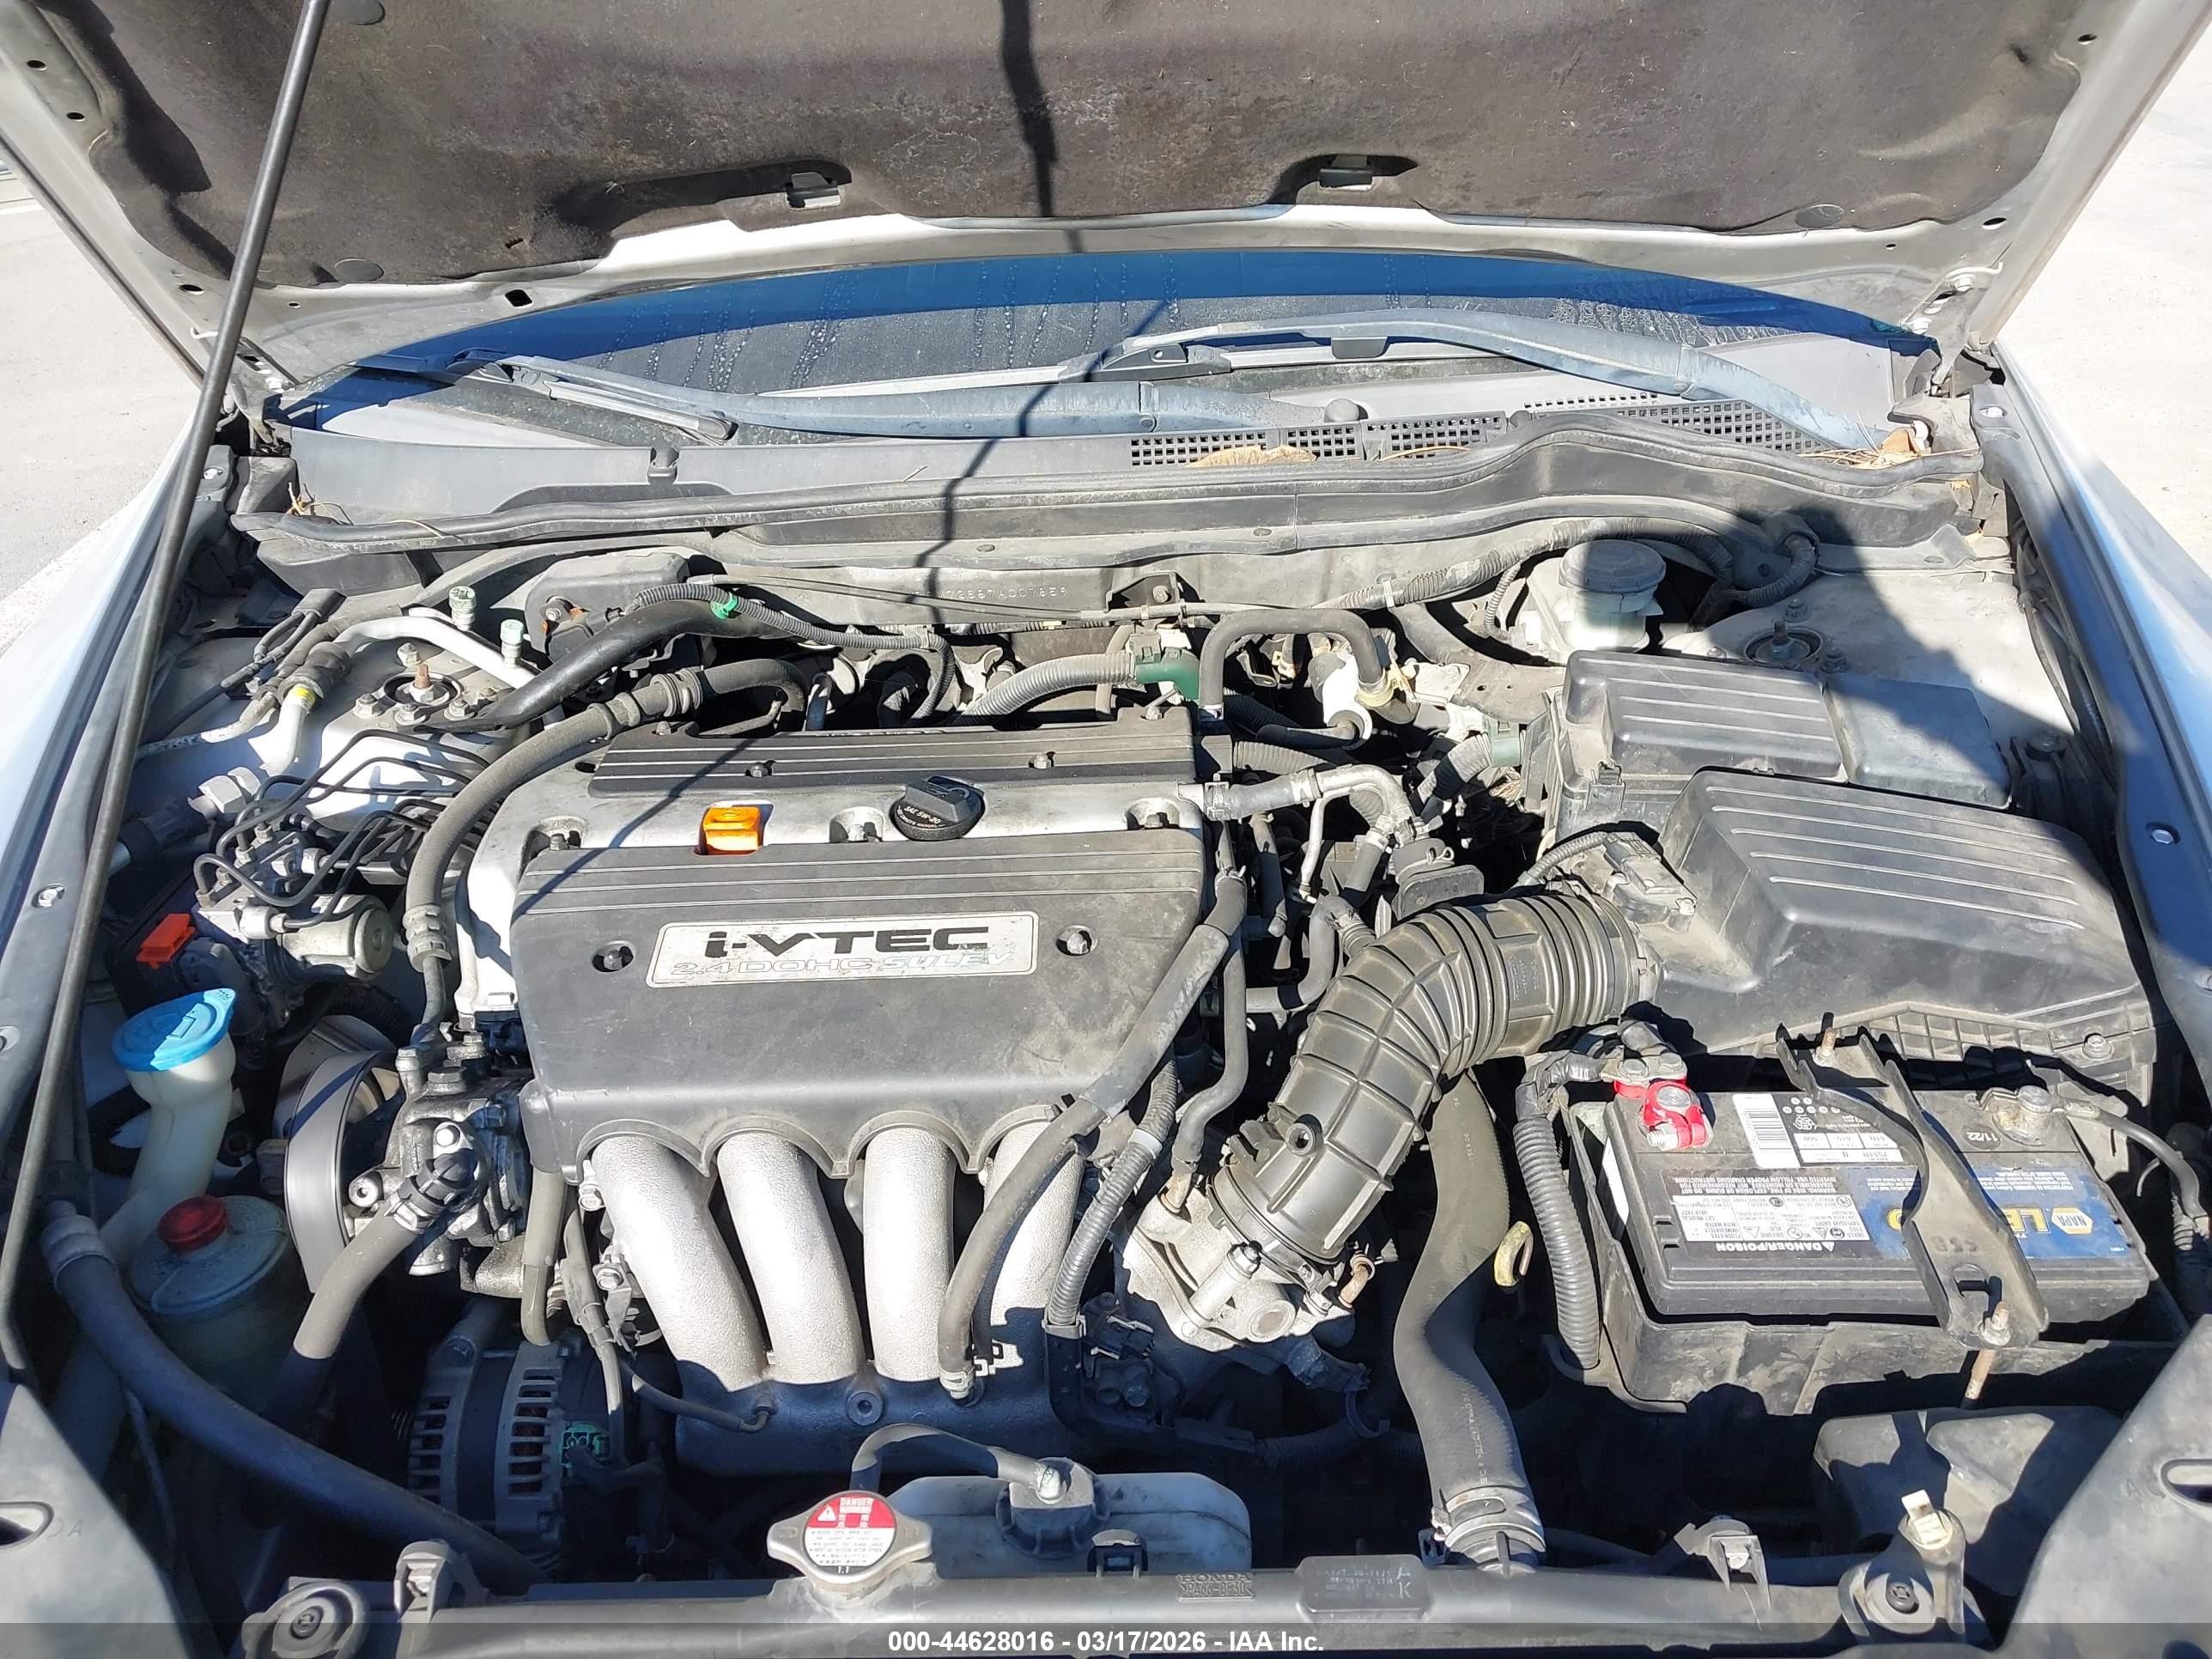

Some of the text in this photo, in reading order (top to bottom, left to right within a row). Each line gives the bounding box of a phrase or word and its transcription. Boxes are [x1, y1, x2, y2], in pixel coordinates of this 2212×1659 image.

[904, 805, 941, 823] SAE 5W-20
[703, 926, 990, 958] i-VTEC
[670, 951, 1014, 976] 2.4 DOHC SULEV
[1966, 1132, 1999, 1142] 11/22
[2057, 1215, 2086, 1227] NAPA
[1716, 1242, 1822, 1251] DANGER/POISON
[1180, 1573, 1252, 1583] HONDA
